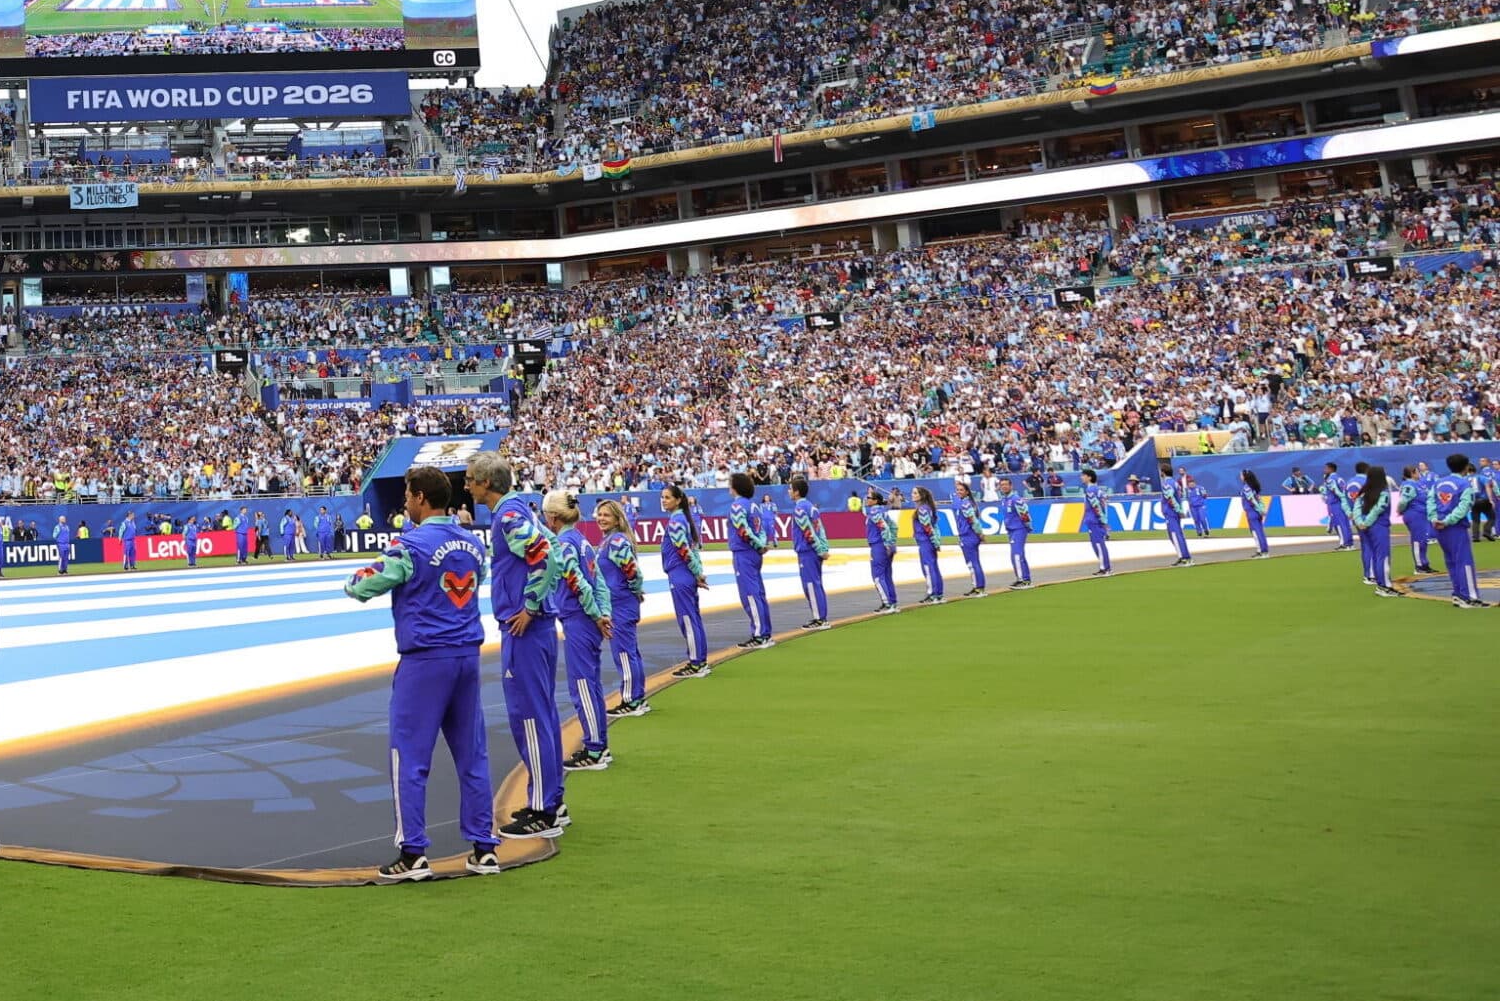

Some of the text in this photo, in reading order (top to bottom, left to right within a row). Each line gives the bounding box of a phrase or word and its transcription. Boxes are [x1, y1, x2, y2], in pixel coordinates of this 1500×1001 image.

[435, 52, 453, 64] CC
[67, 83, 374, 110] FIFA WORLD CUP 2026
[72, 184, 135, 205] 3 MILLONES DE
[86, 194, 127, 206] ILUSIONES
[6, 544, 76, 563] HYUNDI
